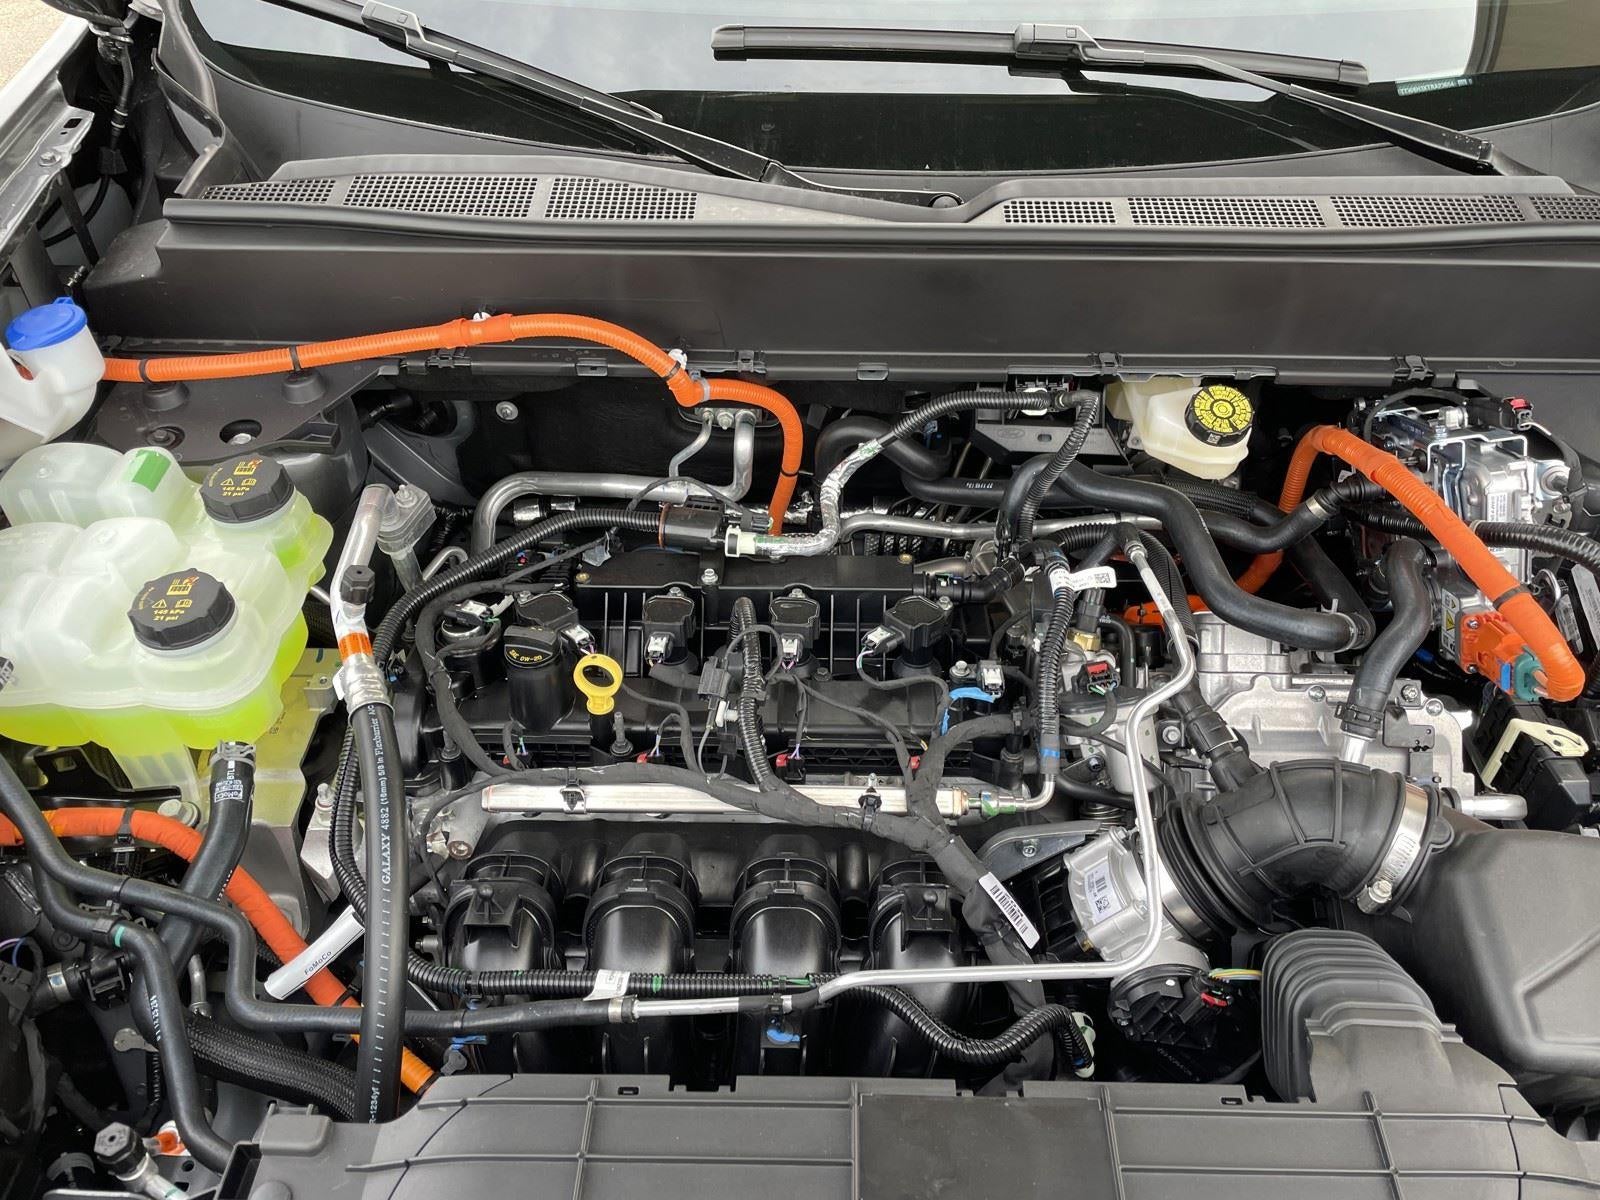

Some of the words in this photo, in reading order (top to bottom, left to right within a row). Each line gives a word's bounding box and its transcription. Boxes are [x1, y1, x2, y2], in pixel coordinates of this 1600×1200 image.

[367, 704, 375, 715] A/C
[370, 717, 384, 756] Flexbarrier
[380, 807, 390, 830] 4882
[381, 833, 391, 885] GALAXY
[304, 951, 332, 975] FoMoCo
